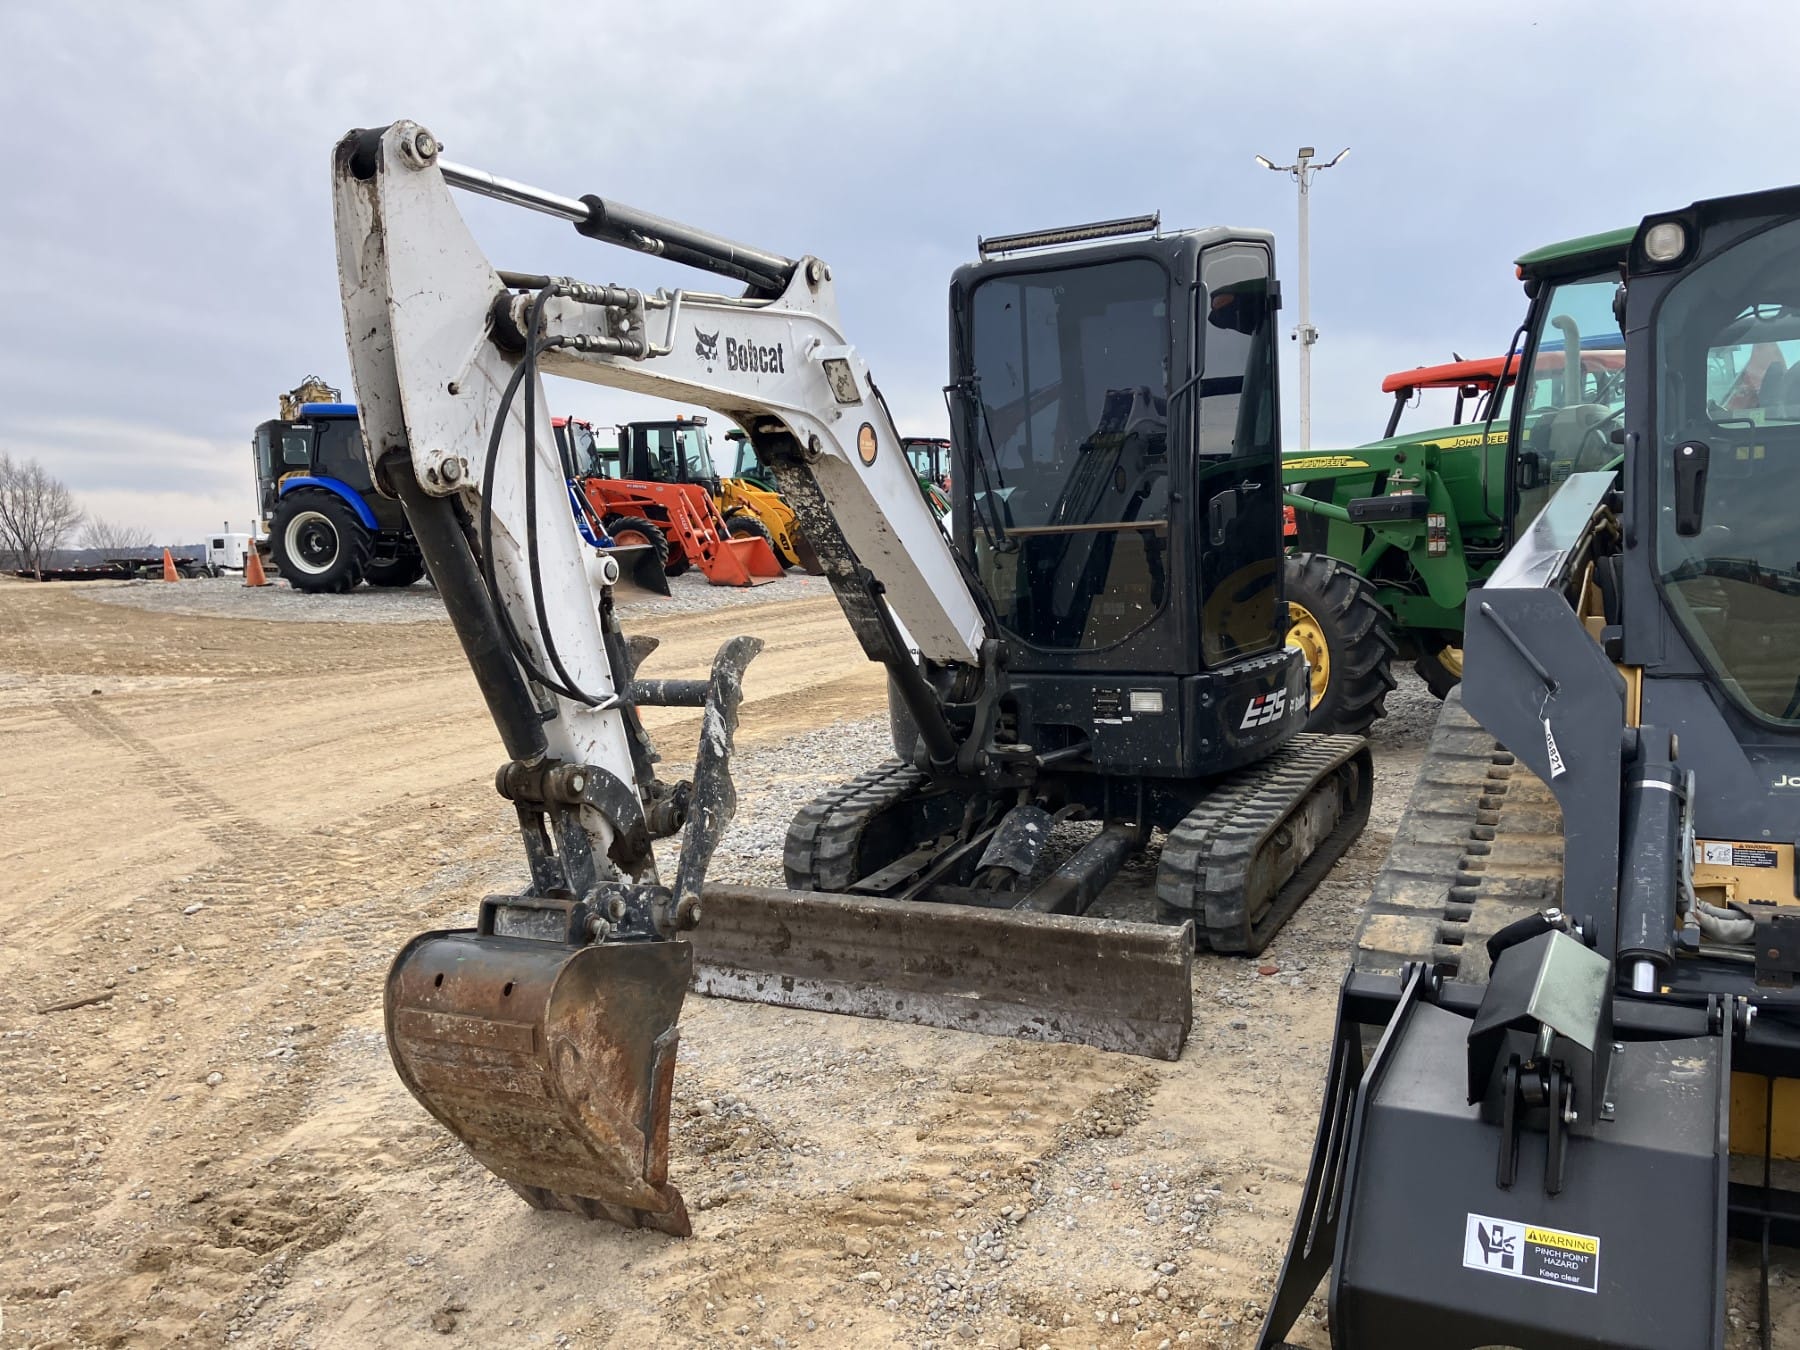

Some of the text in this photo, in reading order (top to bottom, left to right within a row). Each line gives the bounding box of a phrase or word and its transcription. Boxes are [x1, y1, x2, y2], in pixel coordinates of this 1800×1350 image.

[725, 337, 785, 374] Bobcat
[1452, 437, 1481, 447] JOHN
[1239, 687, 1288, 730] E55
[1539, 1233, 1595, 1252] WARNING
[1535, 1246, 1589, 1263] PINCH POINT
[1544, 1257, 1579, 1270] HAZARD
[1539, 1268, 1580, 1283] Keep clear
